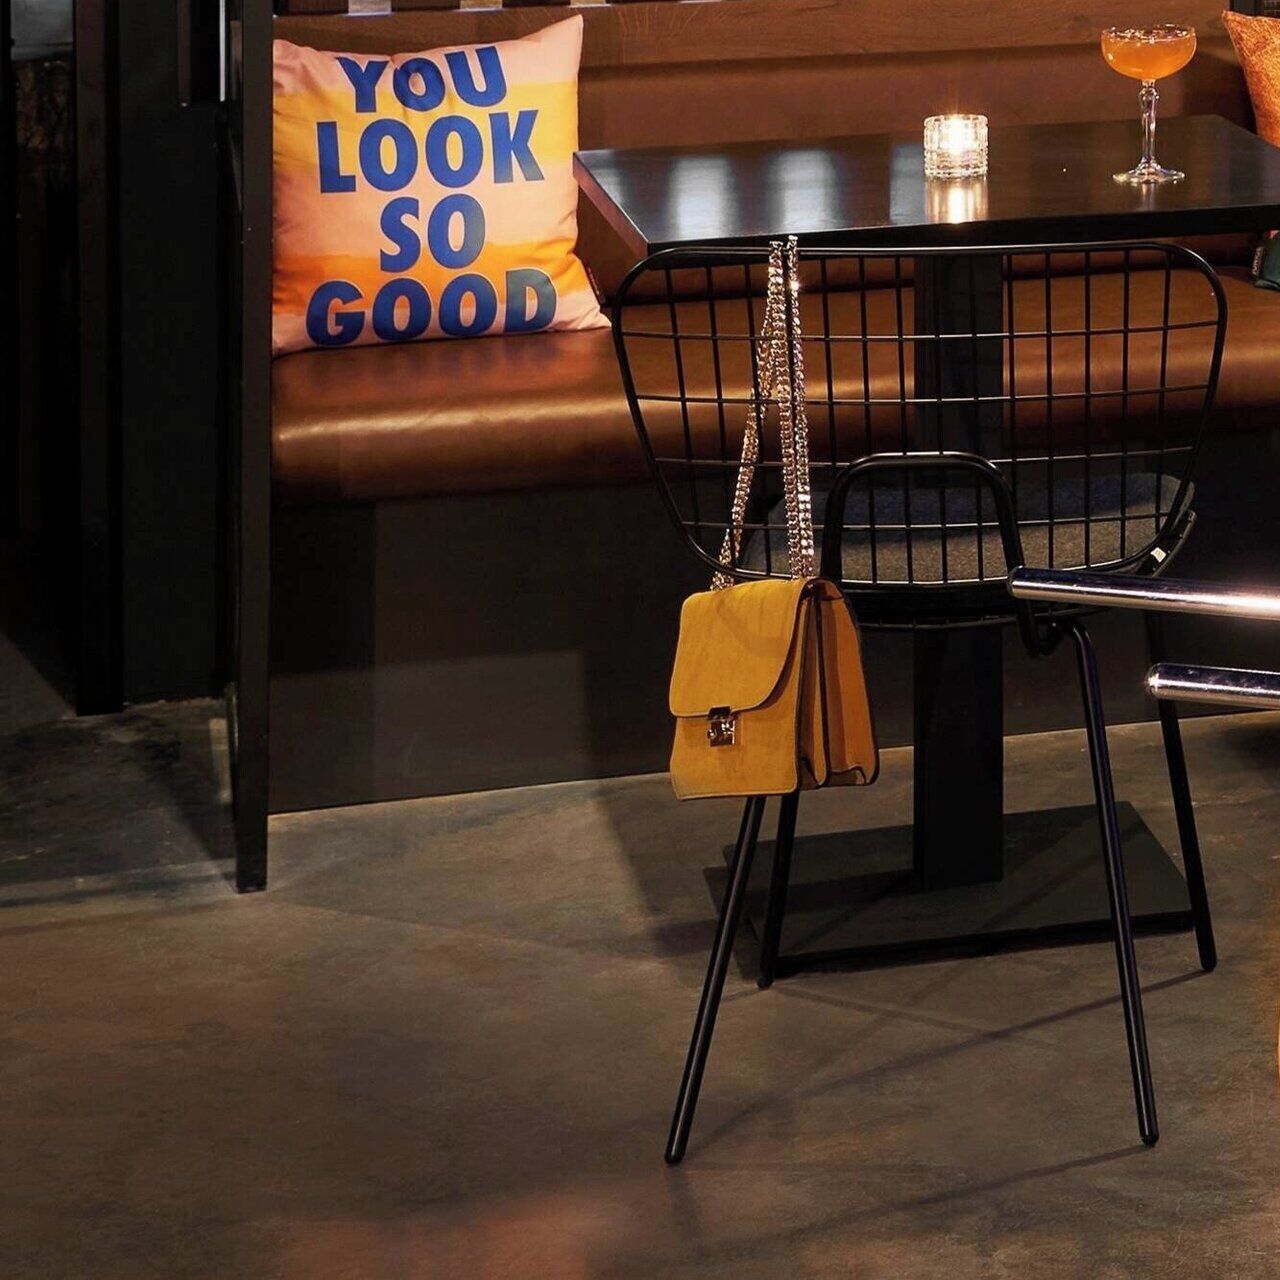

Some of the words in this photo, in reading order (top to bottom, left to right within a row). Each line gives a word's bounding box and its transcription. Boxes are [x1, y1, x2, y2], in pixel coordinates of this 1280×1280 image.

[336, 46, 507, 113] YOU
[316, 109, 545, 194] LOOK
[380, 193, 486, 273] SO
[306, 268, 557, 347] GOOD
